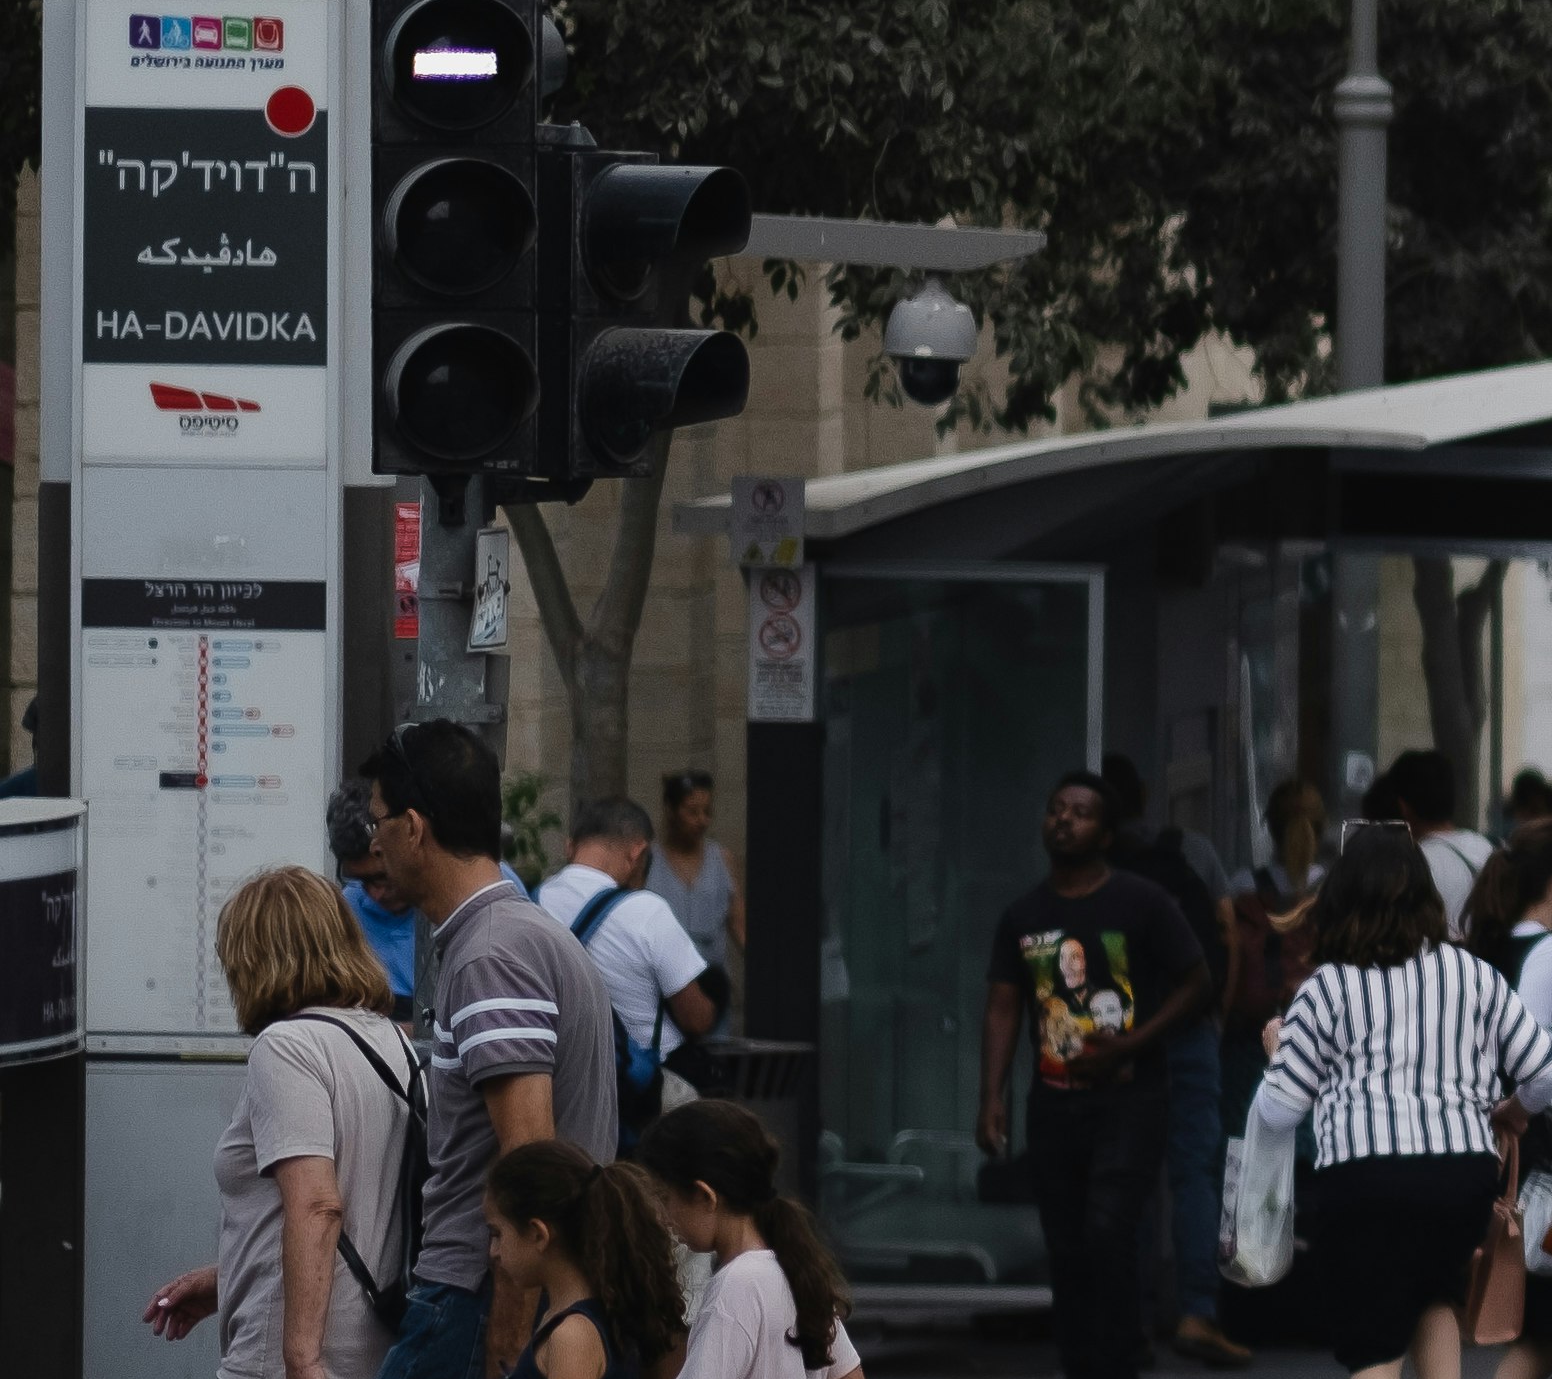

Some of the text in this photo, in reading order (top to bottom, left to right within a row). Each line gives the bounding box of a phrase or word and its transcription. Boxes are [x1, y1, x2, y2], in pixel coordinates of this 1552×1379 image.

[95, 310, 317, 343] HA-DAVIDKA
[144, 581, 187, 598] הרצל
[192, 583, 215, 598] הר
